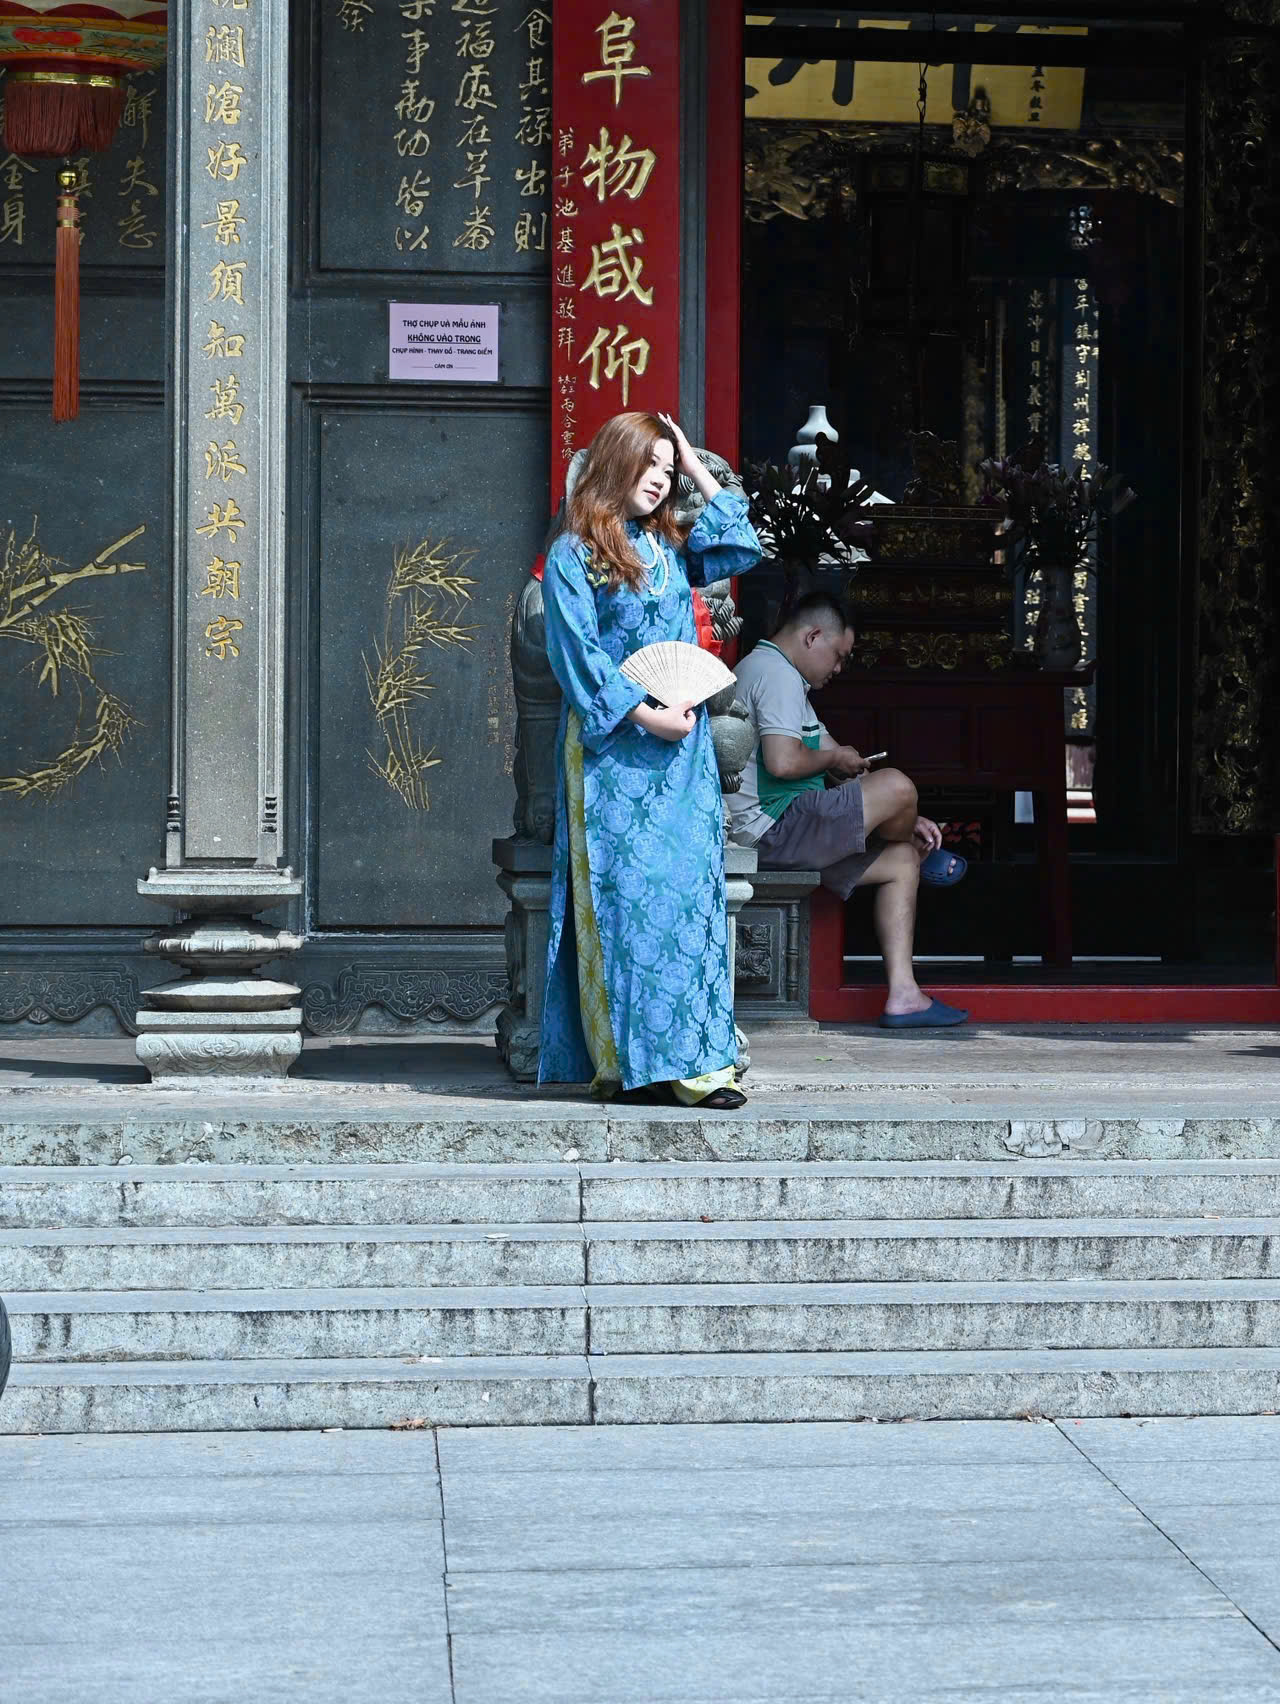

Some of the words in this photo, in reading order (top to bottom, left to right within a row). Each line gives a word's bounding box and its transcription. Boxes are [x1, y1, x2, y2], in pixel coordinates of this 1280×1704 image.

[579, 10, 656, 407] 阜物咸仰
[195, 0, 248, 661] 瀾滄好景須知萬派共朝宗
[407, 333, 434, 342] KHÔNG
[436, 333, 453, 342] VÀO
[455, 335, 481, 343] TRONG
[419, 320, 439, 329] CHỤP
